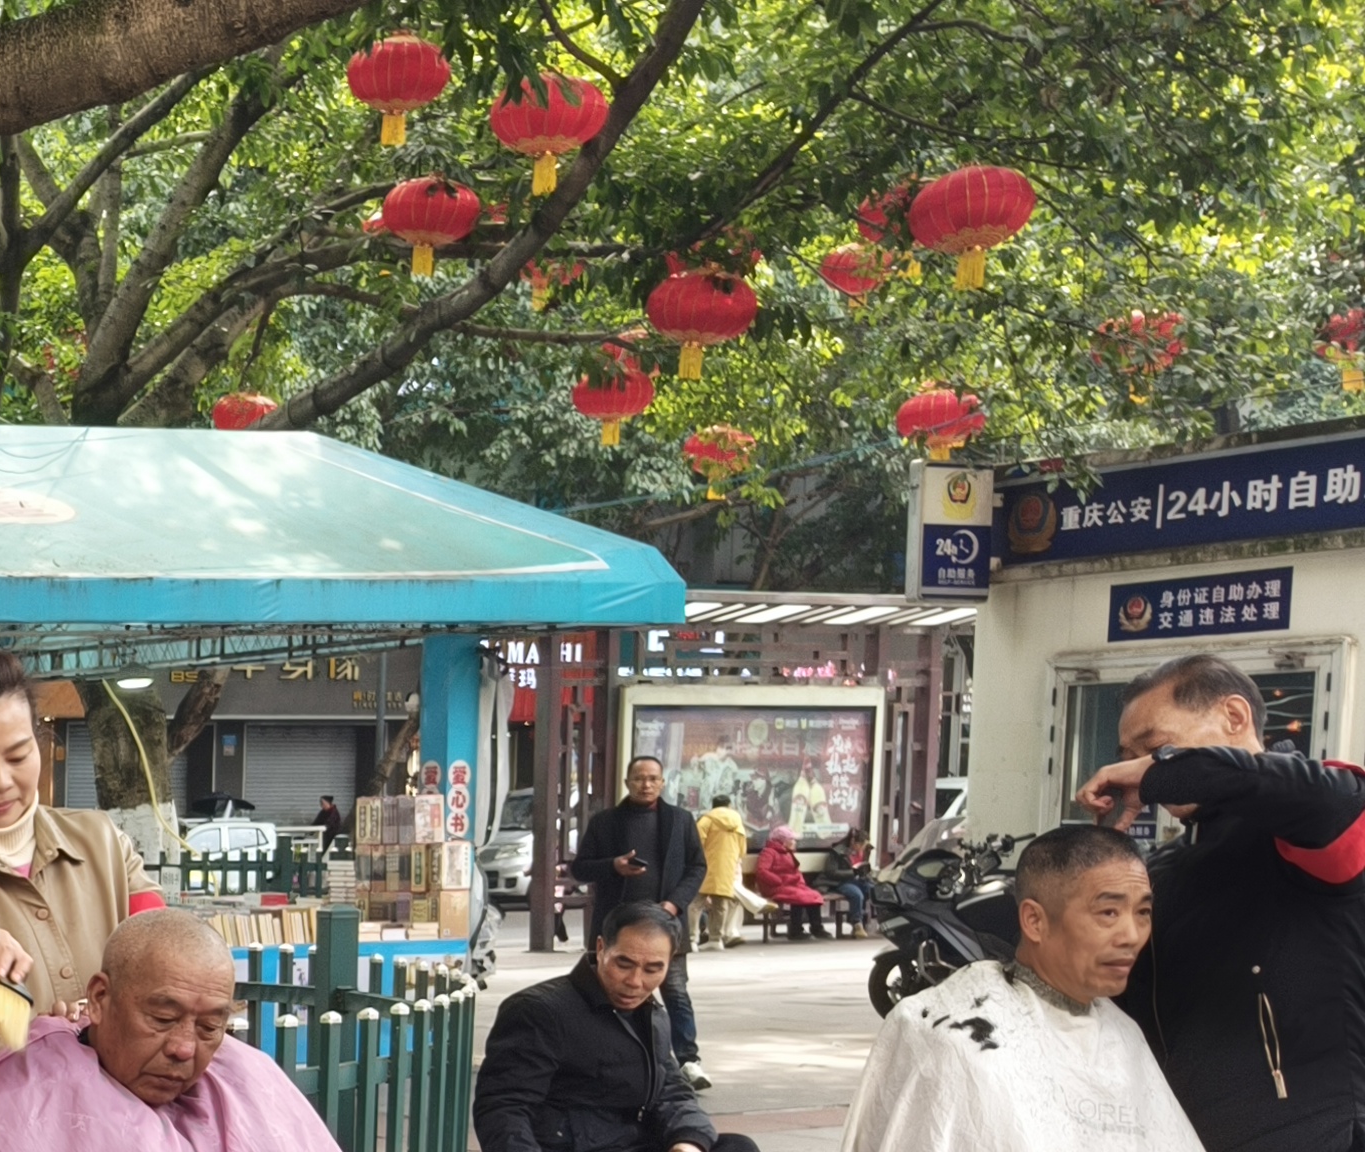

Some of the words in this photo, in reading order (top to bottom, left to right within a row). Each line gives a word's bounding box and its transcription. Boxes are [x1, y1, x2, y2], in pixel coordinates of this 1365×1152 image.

[1060, 496, 1152, 531] 重庆公安
[1159, 580, 1282, 609] 身份证自助办理
[1157, 601, 1280, 631] 交通违法处理
